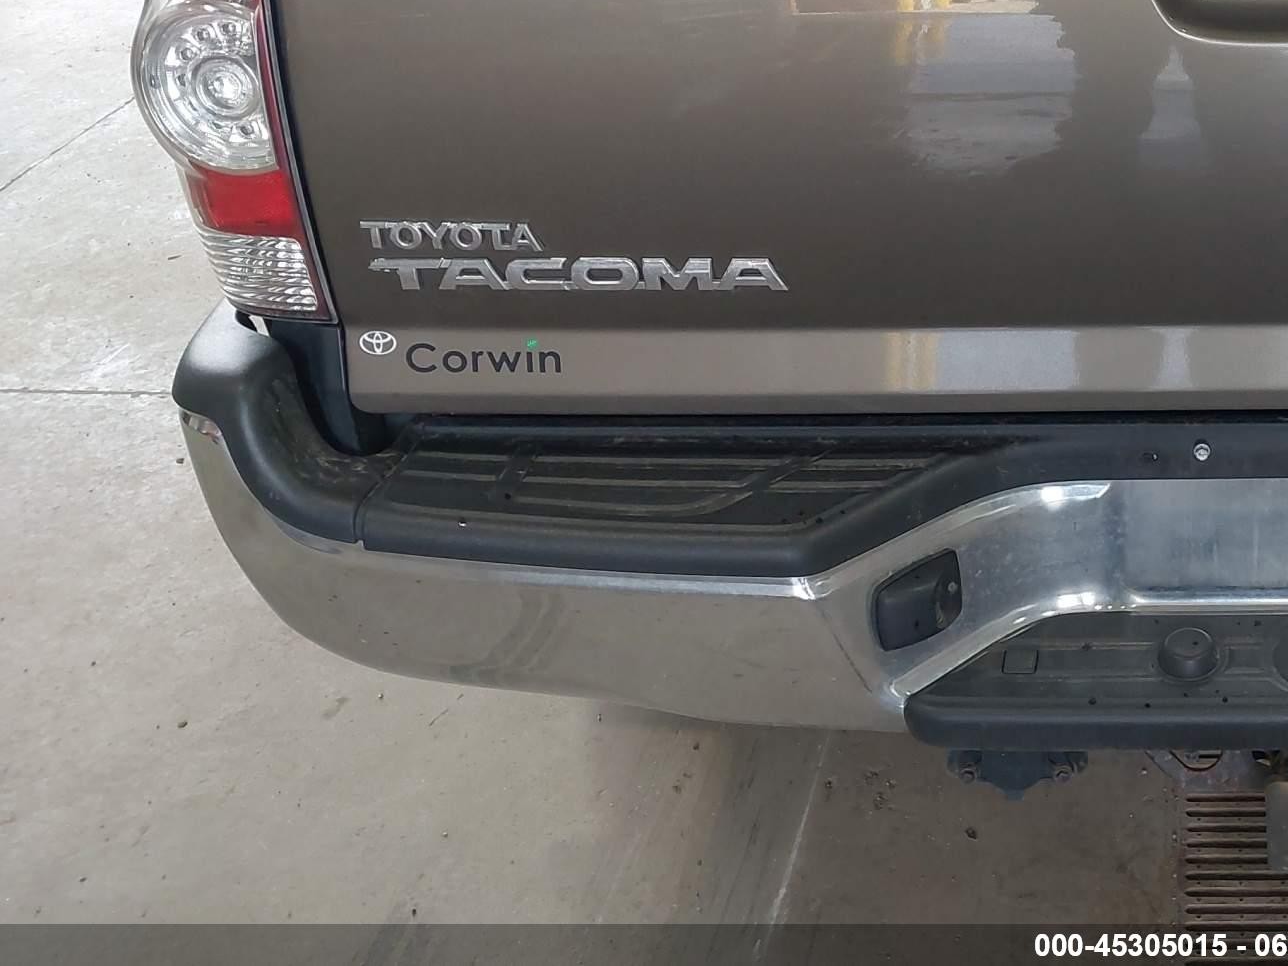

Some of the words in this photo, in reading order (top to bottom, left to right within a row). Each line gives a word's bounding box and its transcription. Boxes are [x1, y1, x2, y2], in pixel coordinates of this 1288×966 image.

[360, 220, 543, 251] TOYOTA
[367, 257, 788, 290] TACOMA
[405, 338, 562, 373] Corwin
